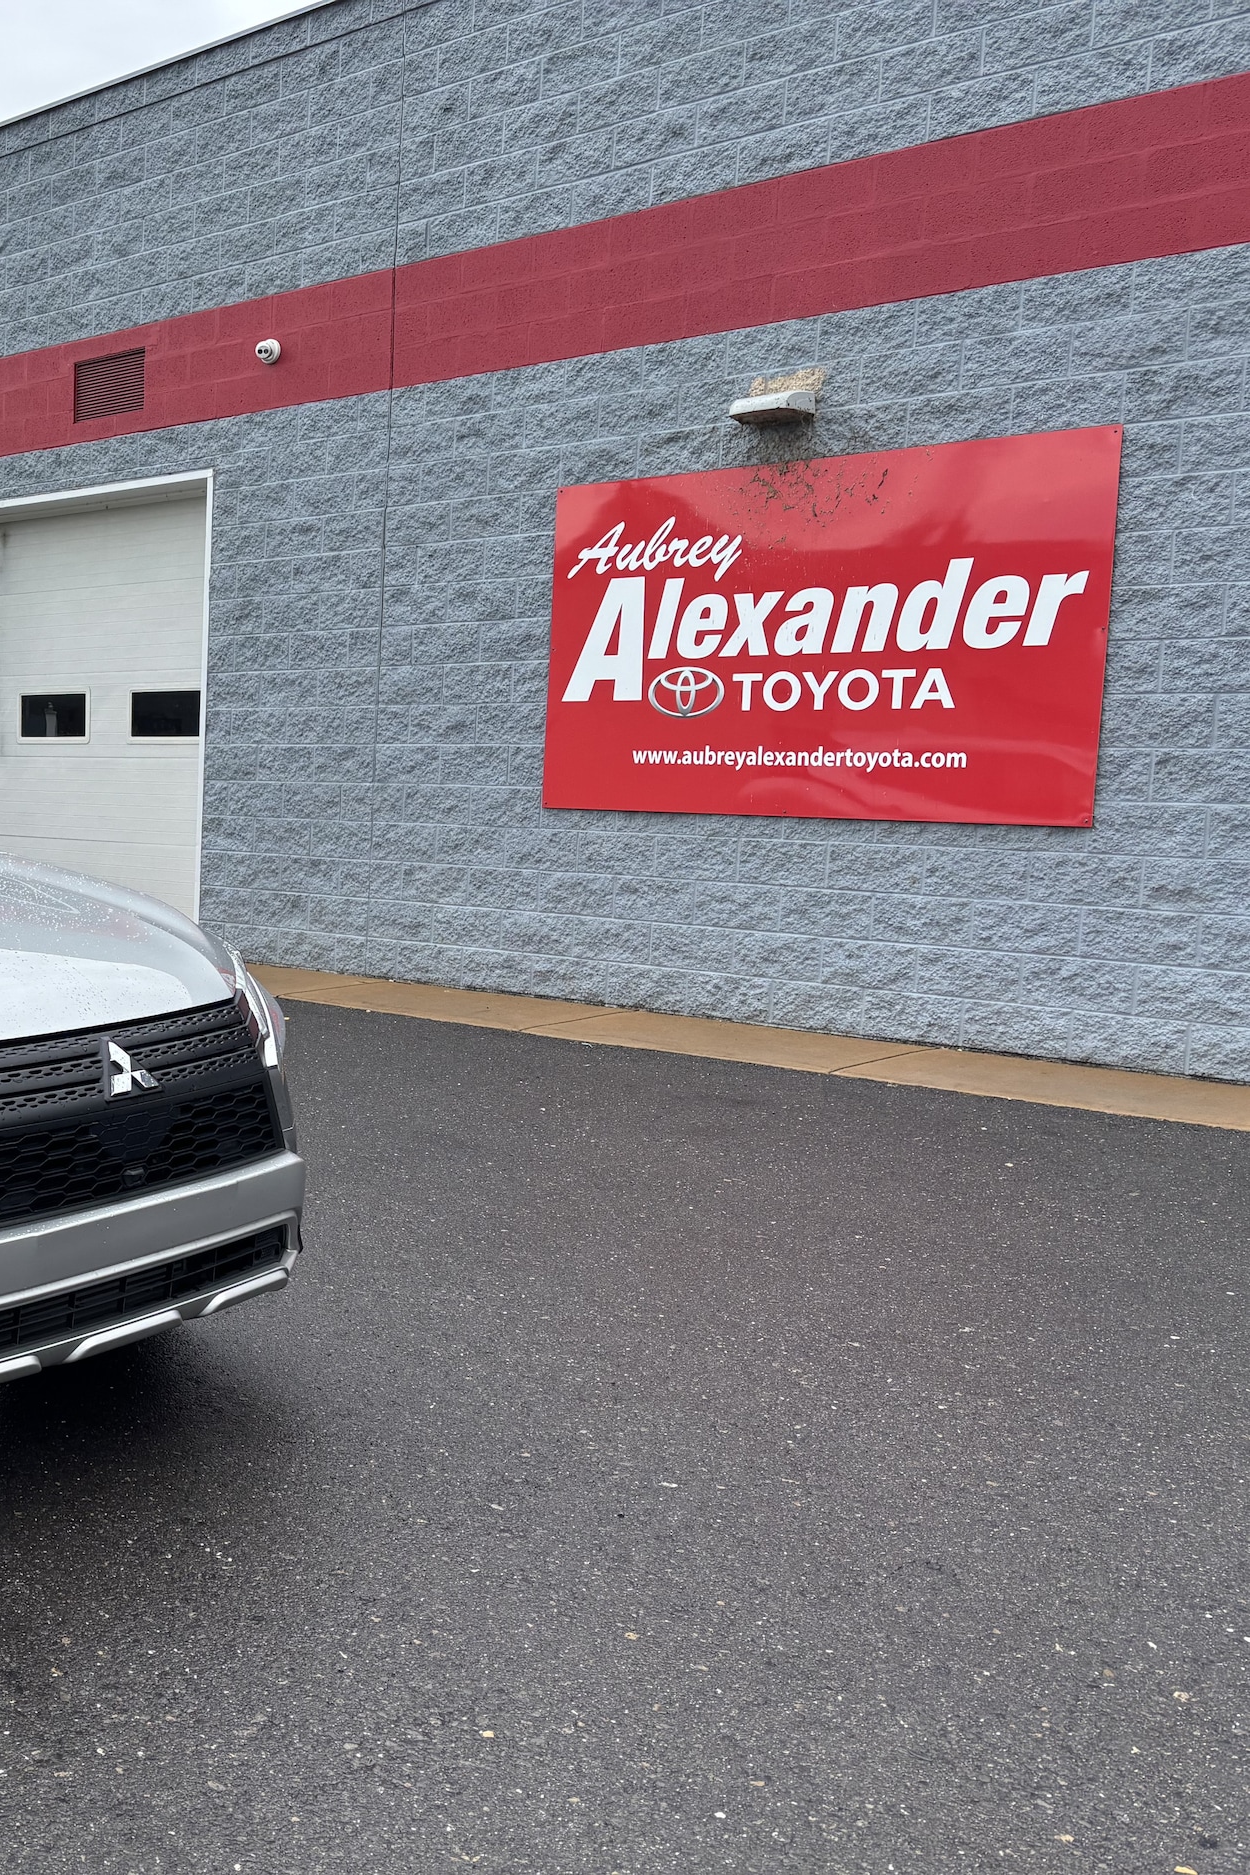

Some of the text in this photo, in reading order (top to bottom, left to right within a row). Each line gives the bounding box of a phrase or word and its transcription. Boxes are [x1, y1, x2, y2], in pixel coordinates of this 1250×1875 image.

[567, 516, 743, 581] Aubrey
[561, 557, 1090, 702] Alexander
[732, 667, 956, 712] TOYOTA
[632, 745, 968, 772] www.aubreyalexandertoyota.com
